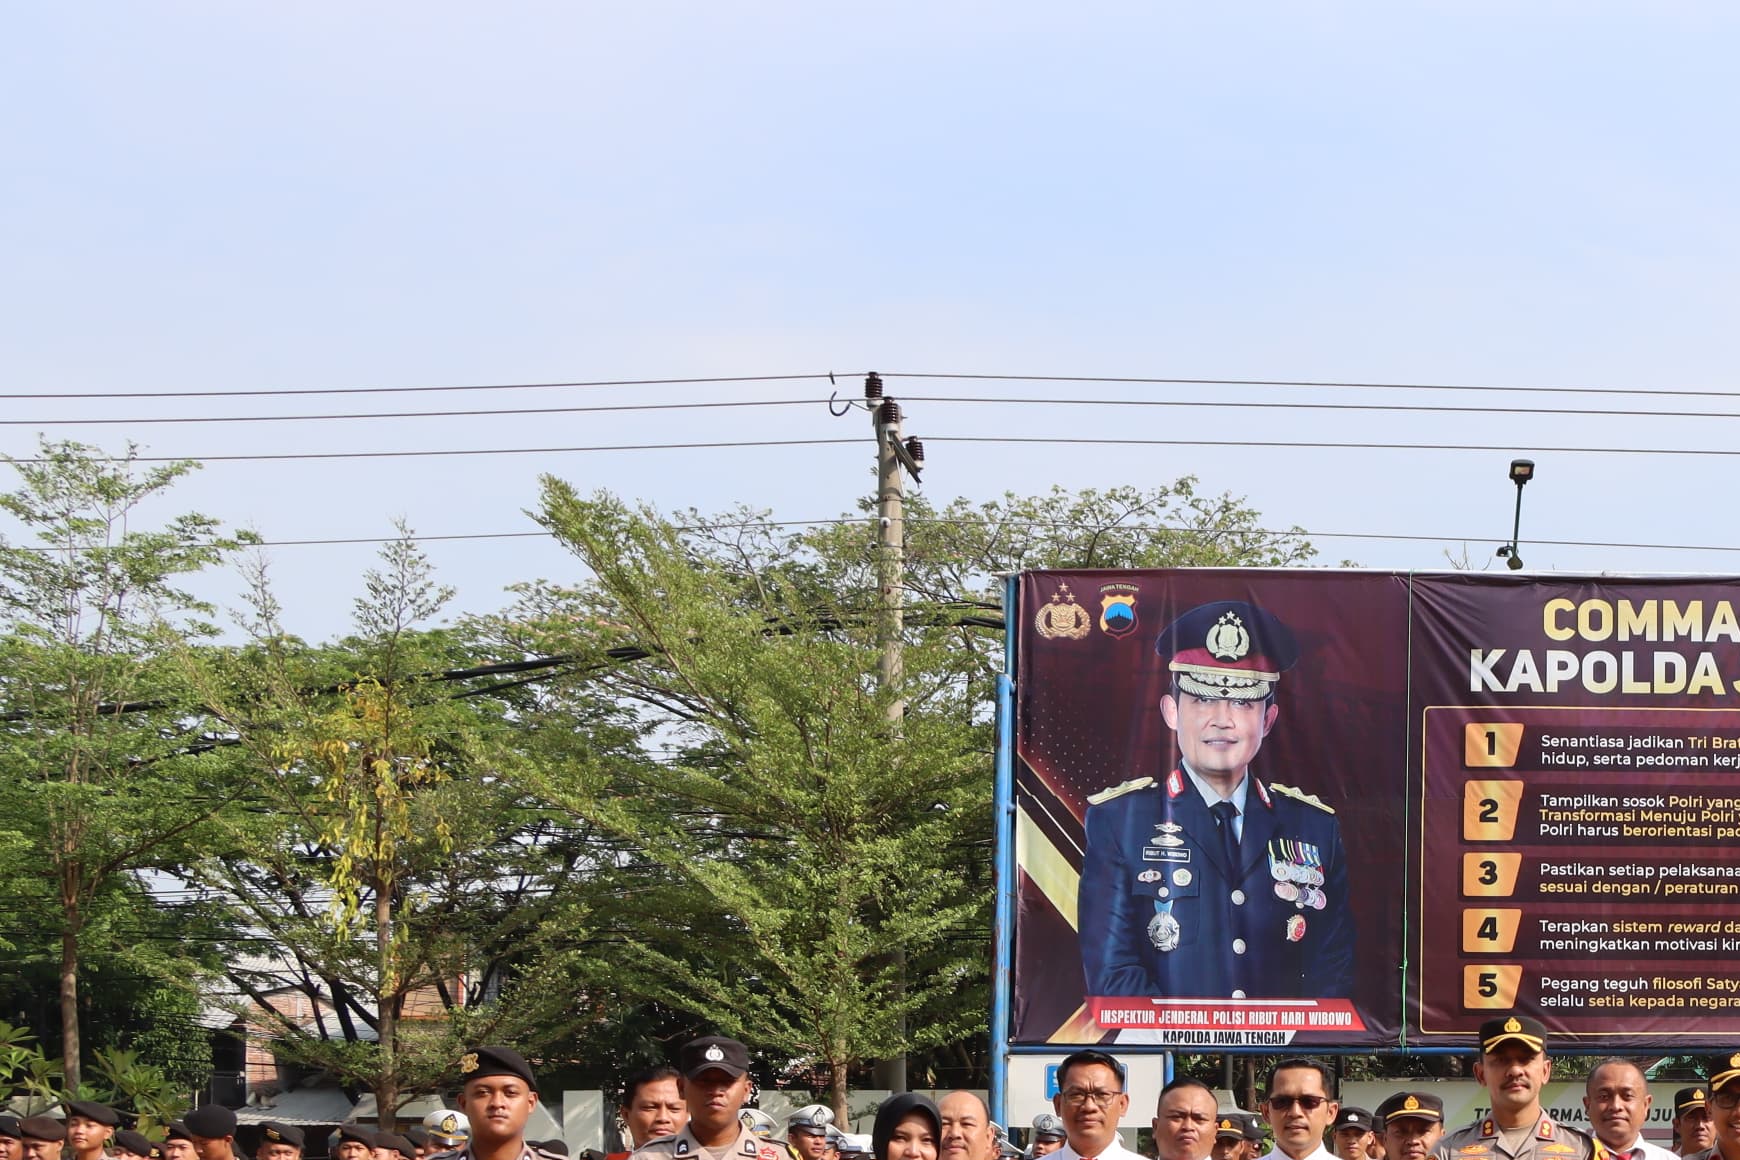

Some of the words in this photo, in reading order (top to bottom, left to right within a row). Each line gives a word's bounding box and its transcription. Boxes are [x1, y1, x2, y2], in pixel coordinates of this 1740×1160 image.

[1100, 584, 1115, 593] JAWA
[1115, 583, 1140, 592] TENGAH
[1470, 648, 1725, 694] KAPOLDA
[1485, 731, 1496, 756] 1
[1541, 735, 1624, 748] Senantiasa
[1627, 736, 1684, 750] jadikan
[1688, 736, 1707, 749] Tri
[1542, 752, 1589, 767] hidup,
[1593, 753, 1631, 766] serta
[1636, 753, 1708, 769] pedoman
[1541, 794, 1618, 810] Tampilkan
[1622, 795, 1665, 808] sosok
[1669, 796, 1703, 808] Polri
[1478, 798, 1499, 823] 2
[1539, 809, 1636, 823] Transformasi
[1640, 810, 1697, 825] Menuju
[1701, 810, 1734, 823] Polri
[1539, 824, 1573, 837] Polri
[1577, 824, 1619, 837] harus
[1623, 825, 1712, 838] berorientasi
[1478, 861, 1498, 886] 3
[1539, 863, 1604, 877] Pastikan
[1608, 864, 1655, 879] setiap
[1539, 881, 1588, 894] sesuai
[1591, 881, 1650, 897] dengan
[1654, 881, 1662, 895] /
[1664, 882, 1739, 898] peraturan
[1477, 917, 1499, 941] 4
[1539, 920, 1609, 936] Terapkan
[1612, 921, 1663, 934] sistem
[1667, 921, 1722, 934] reward
[1539, 938, 1650, 953] meningkatkan
[1654, 938, 1718, 951] motivasi
[1478, 973, 1498, 997] 5
[1541, 978, 1600, 993] Pegang
[1603, 978, 1649, 993] teguh
[1652, 978, 1702, 991] filosofi
[1540, 994, 1584, 1007] selalu
[1588, 995, 1625, 1008] setia
[1628, 995, 1685, 1010] kepada
[1101, 1010, 1155, 1024] INSPEKTUR
[1158, 1010, 1210, 1025] JENDERAL
[1213, 1010, 1245, 1025] POLISI
[1248, 1010, 1278, 1026] RIBUT
[1281, 1011, 1305, 1026] HARI
[1308, 1011, 1352, 1026] WIBOWO
[1162, 1030, 1210, 1044] KAPOLDA
[1213, 1031, 1244, 1044] JAWA
[1245, 1031, 1286, 1045] TENGAH
